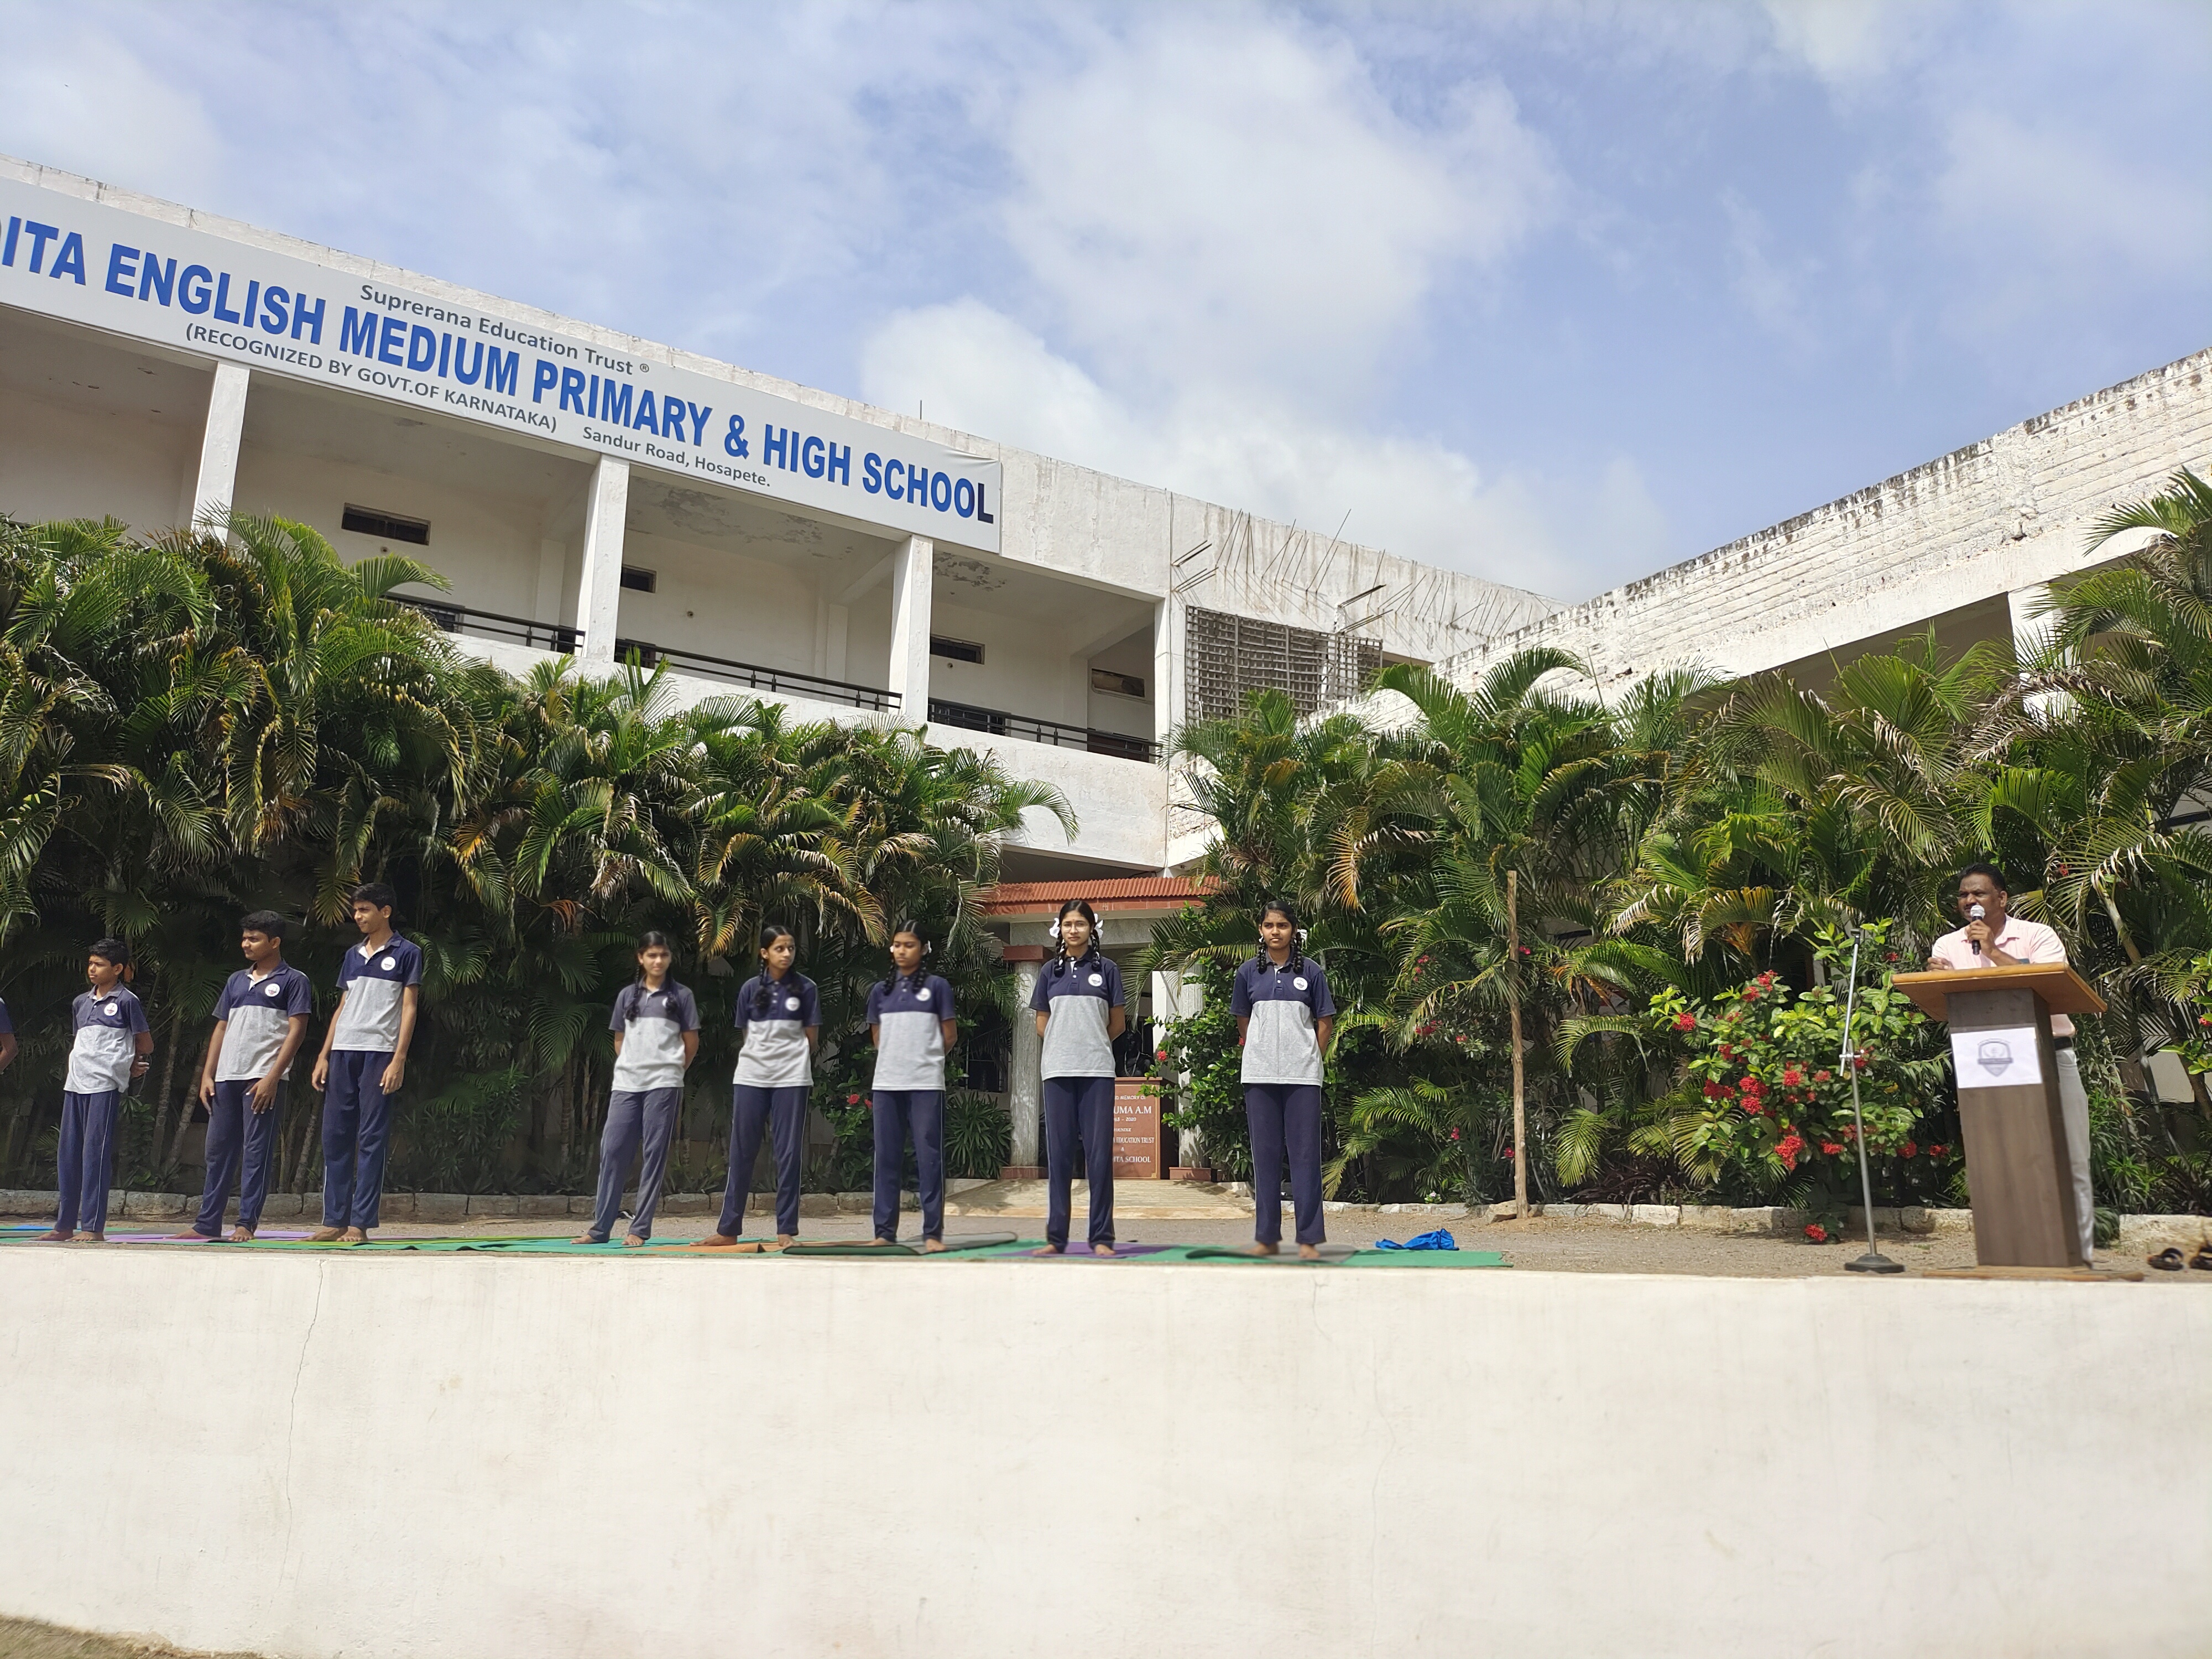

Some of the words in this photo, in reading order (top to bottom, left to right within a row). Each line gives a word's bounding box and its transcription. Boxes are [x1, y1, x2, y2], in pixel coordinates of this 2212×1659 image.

[0, 215, 86, 286] ITA
[105, 242, 326, 345] ENGLISH
[340, 305, 520, 397] MEDIUM
[533, 359, 713, 447] PRIMARY
[724, 414, 749, 459] &
[763, 424, 851, 486] HIGH
[862, 452, 994, 524] SCHOOL
[360, 284, 471, 330] Suprerana
[479, 317, 578, 359] Education
[585, 347, 633, 375] Trust
[186, 322, 322, 369] (RECOGNIZED
[328, 359, 353, 377] BY
[357, 367, 440, 399] GOVT.OF
[444, 389, 557, 434] KARNATAKA)
[582, 426, 641, 452] Sandur
[645, 442, 690, 468] Road,
[695, 455, 770, 488] Hosapete.
[1114, 1105, 1133, 1114] UMA
[1135, 1105, 1152, 1114] A.M
